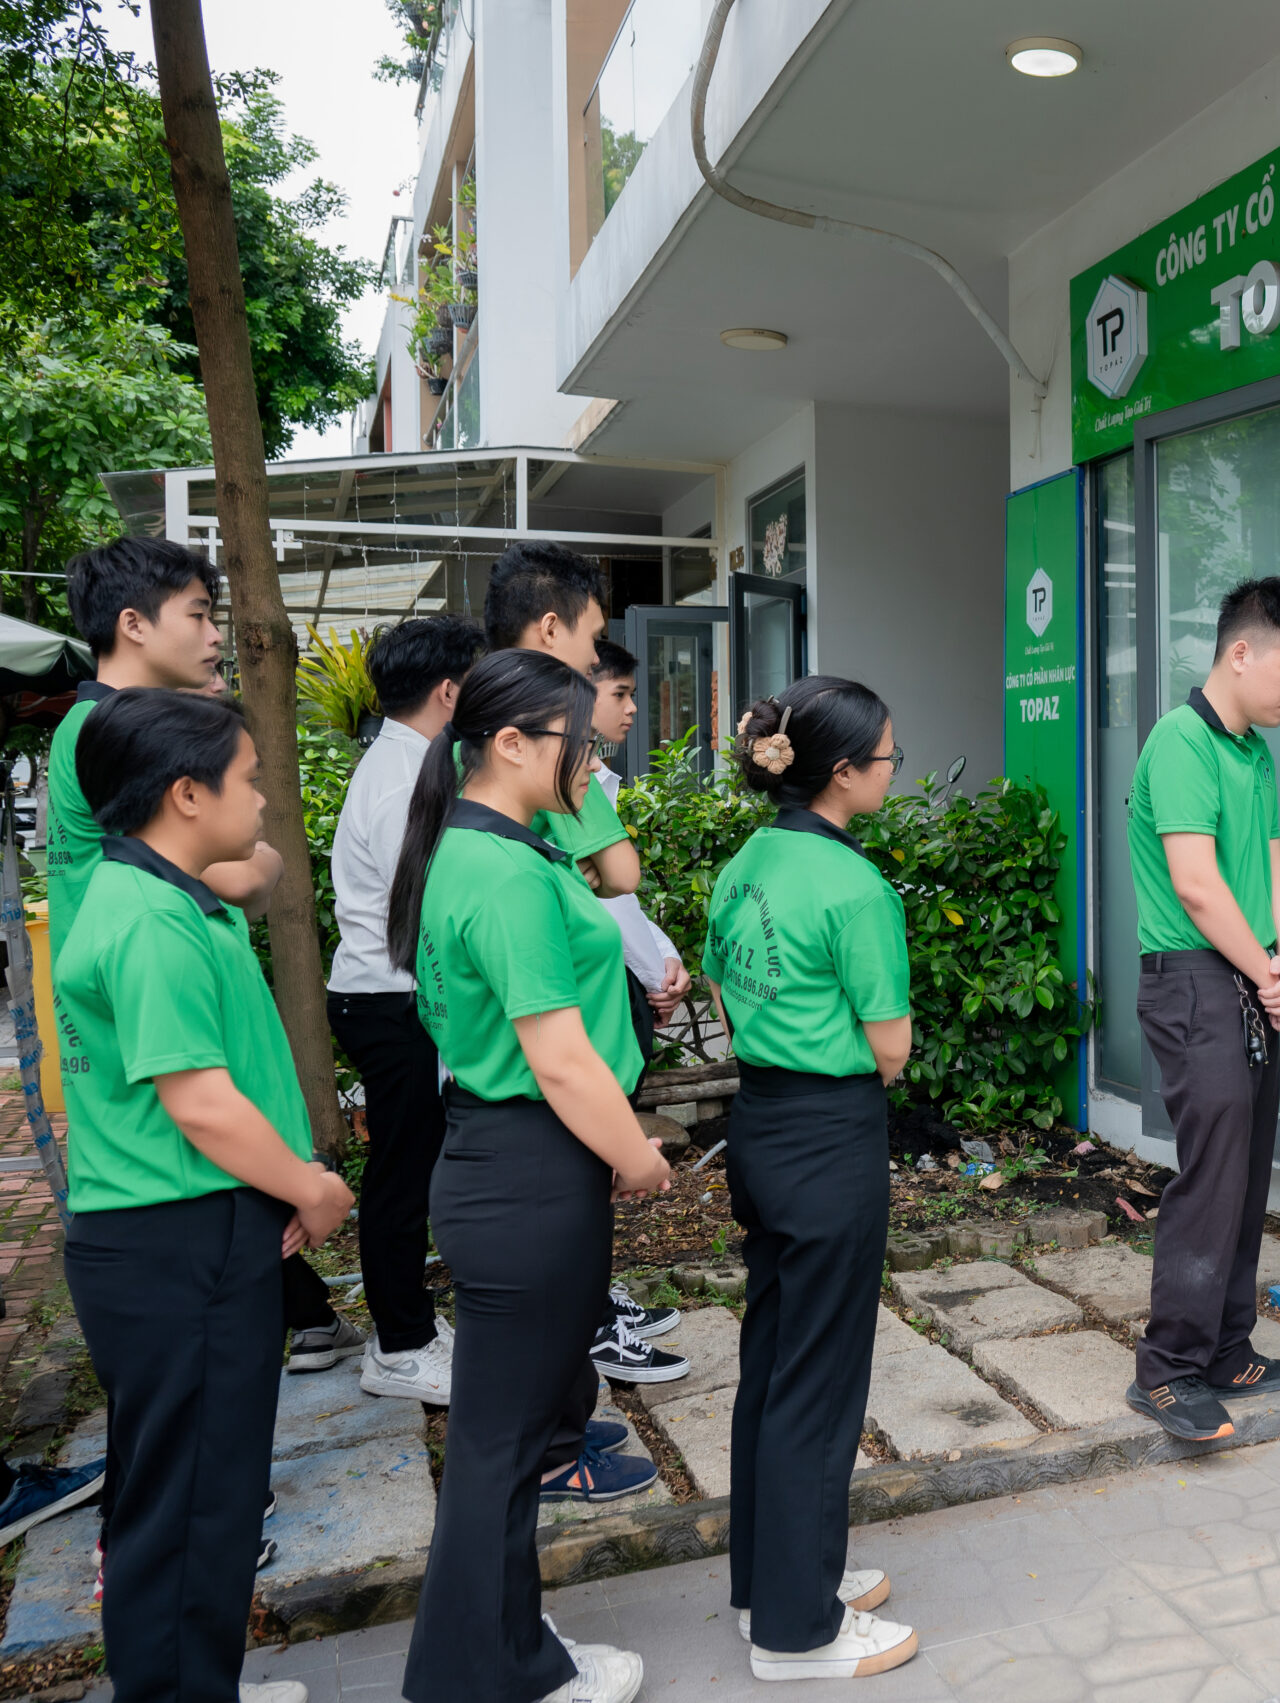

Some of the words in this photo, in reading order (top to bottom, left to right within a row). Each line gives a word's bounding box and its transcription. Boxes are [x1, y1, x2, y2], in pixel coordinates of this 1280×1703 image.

[1155, 225, 1206, 287] CÔNG
[1213, 204, 1239, 254] TY
[1246, 164, 1275, 234] CỔ
[1097, 307, 1124, 357] TP
[1100, 356, 1123, 374] TOPAZ
[1032, 588, 1046, 613] TP
[1006, 672, 1019, 689] CÔNG
[1019, 674, 1026, 688] TY
[1020, 695, 1059, 723] TOPAZ
